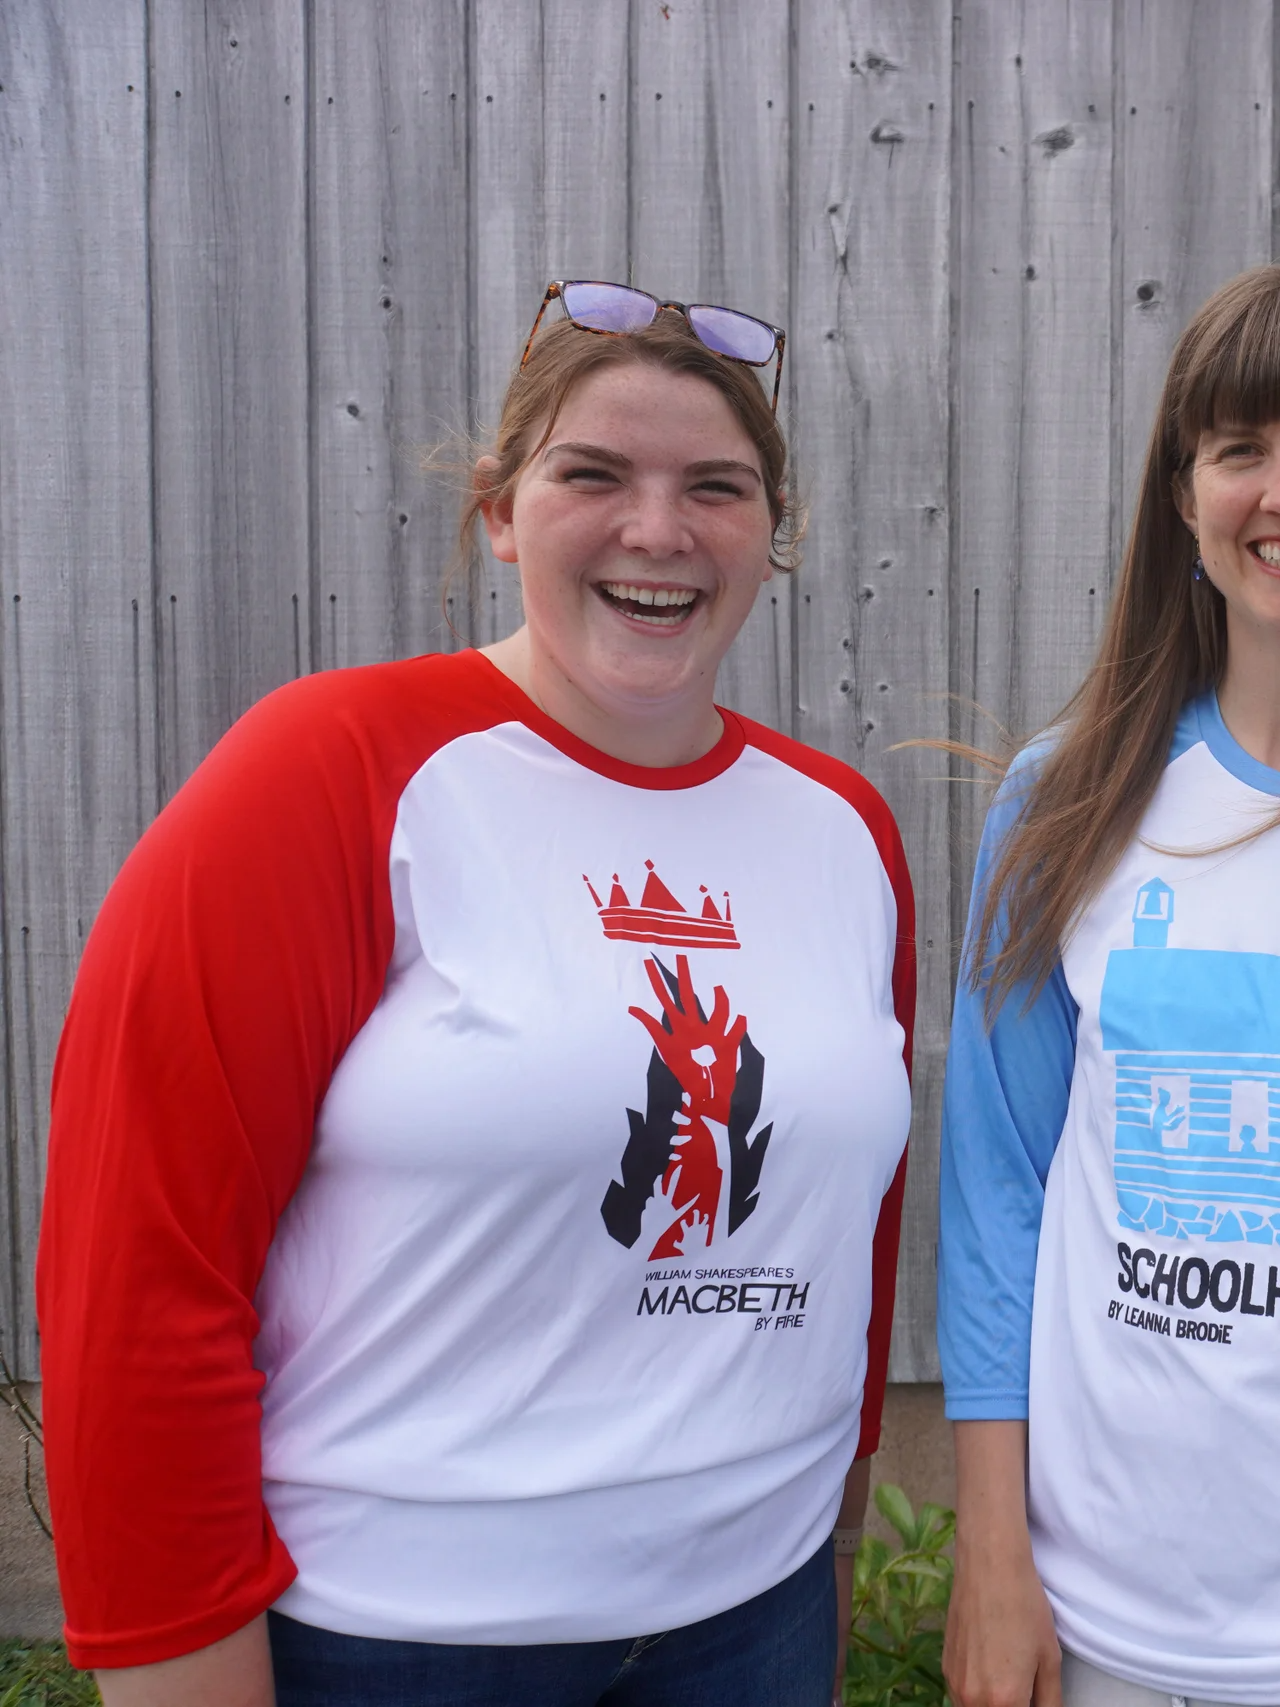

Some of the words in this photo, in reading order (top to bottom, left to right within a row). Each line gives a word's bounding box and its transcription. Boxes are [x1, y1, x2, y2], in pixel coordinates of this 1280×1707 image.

[645, 1269, 691, 1281] WILLIAM
[637, 1282, 810, 1315] MACBETH
[754, 1317, 772, 1331] BY
[775, 1314, 804, 1330] FIRE
[1107, 1300, 1124, 1320] BY
[1124, 1305, 1171, 1336] LEANNA
